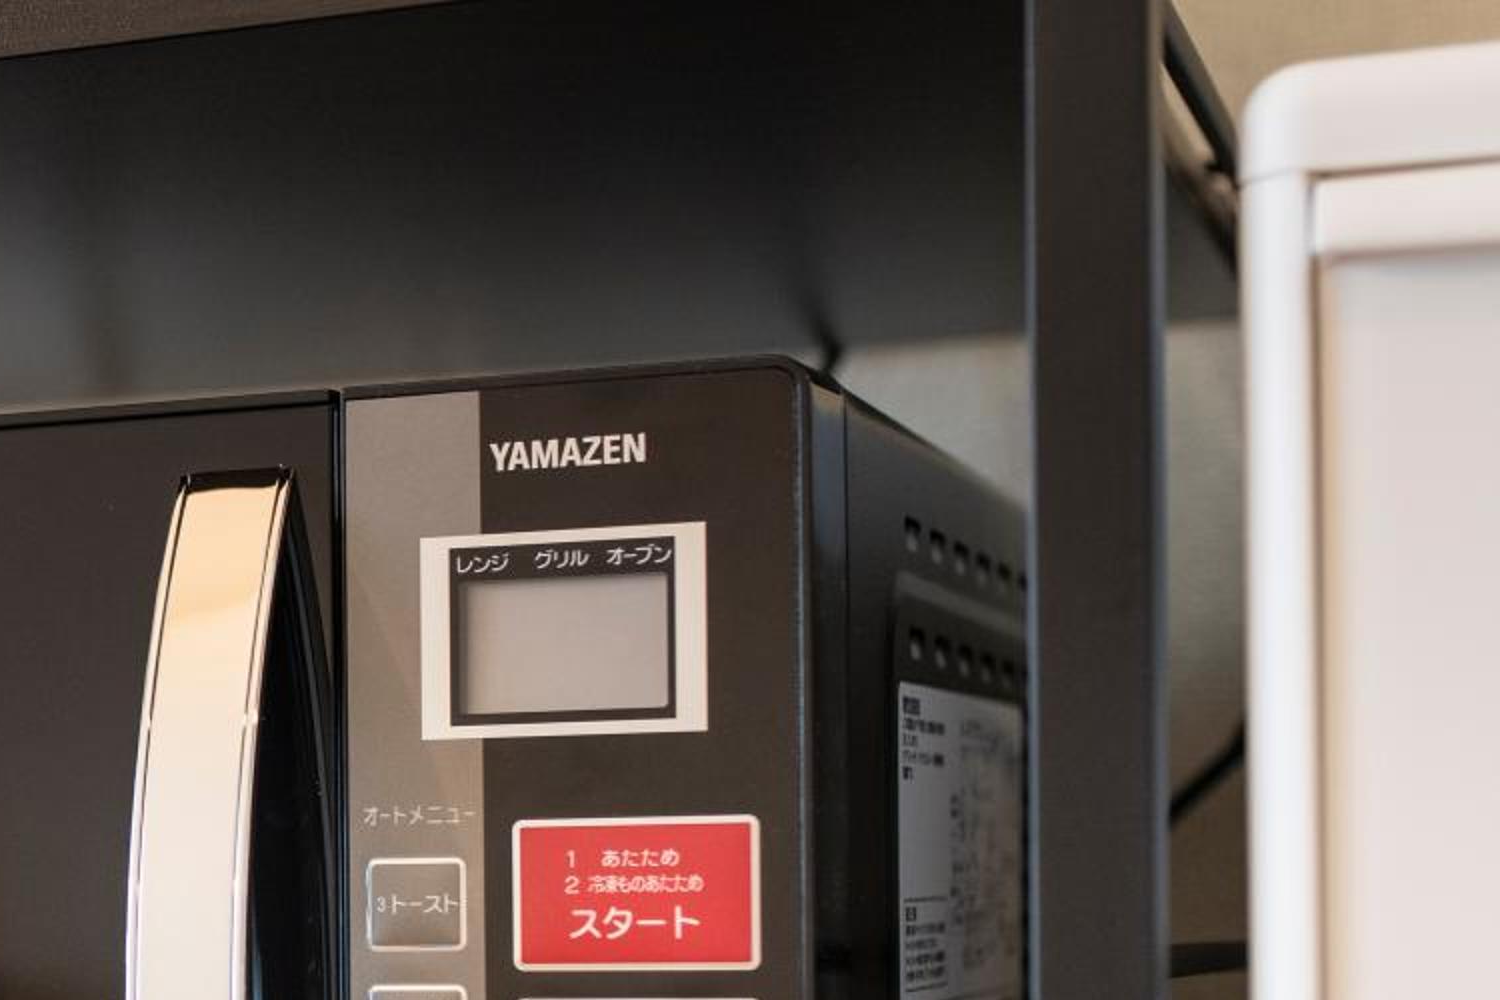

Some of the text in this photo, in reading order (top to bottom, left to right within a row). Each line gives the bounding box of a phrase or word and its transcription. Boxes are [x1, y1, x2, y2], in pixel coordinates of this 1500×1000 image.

[490, 433, 647, 471] YAMAZEN
[456, 543, 672, 574] レンジ グリル オーブン
[363, 806, 476, 827] オートメニュー
[601, 848, 680, 867] あたため
[569, 904, 700, 939] スタート
